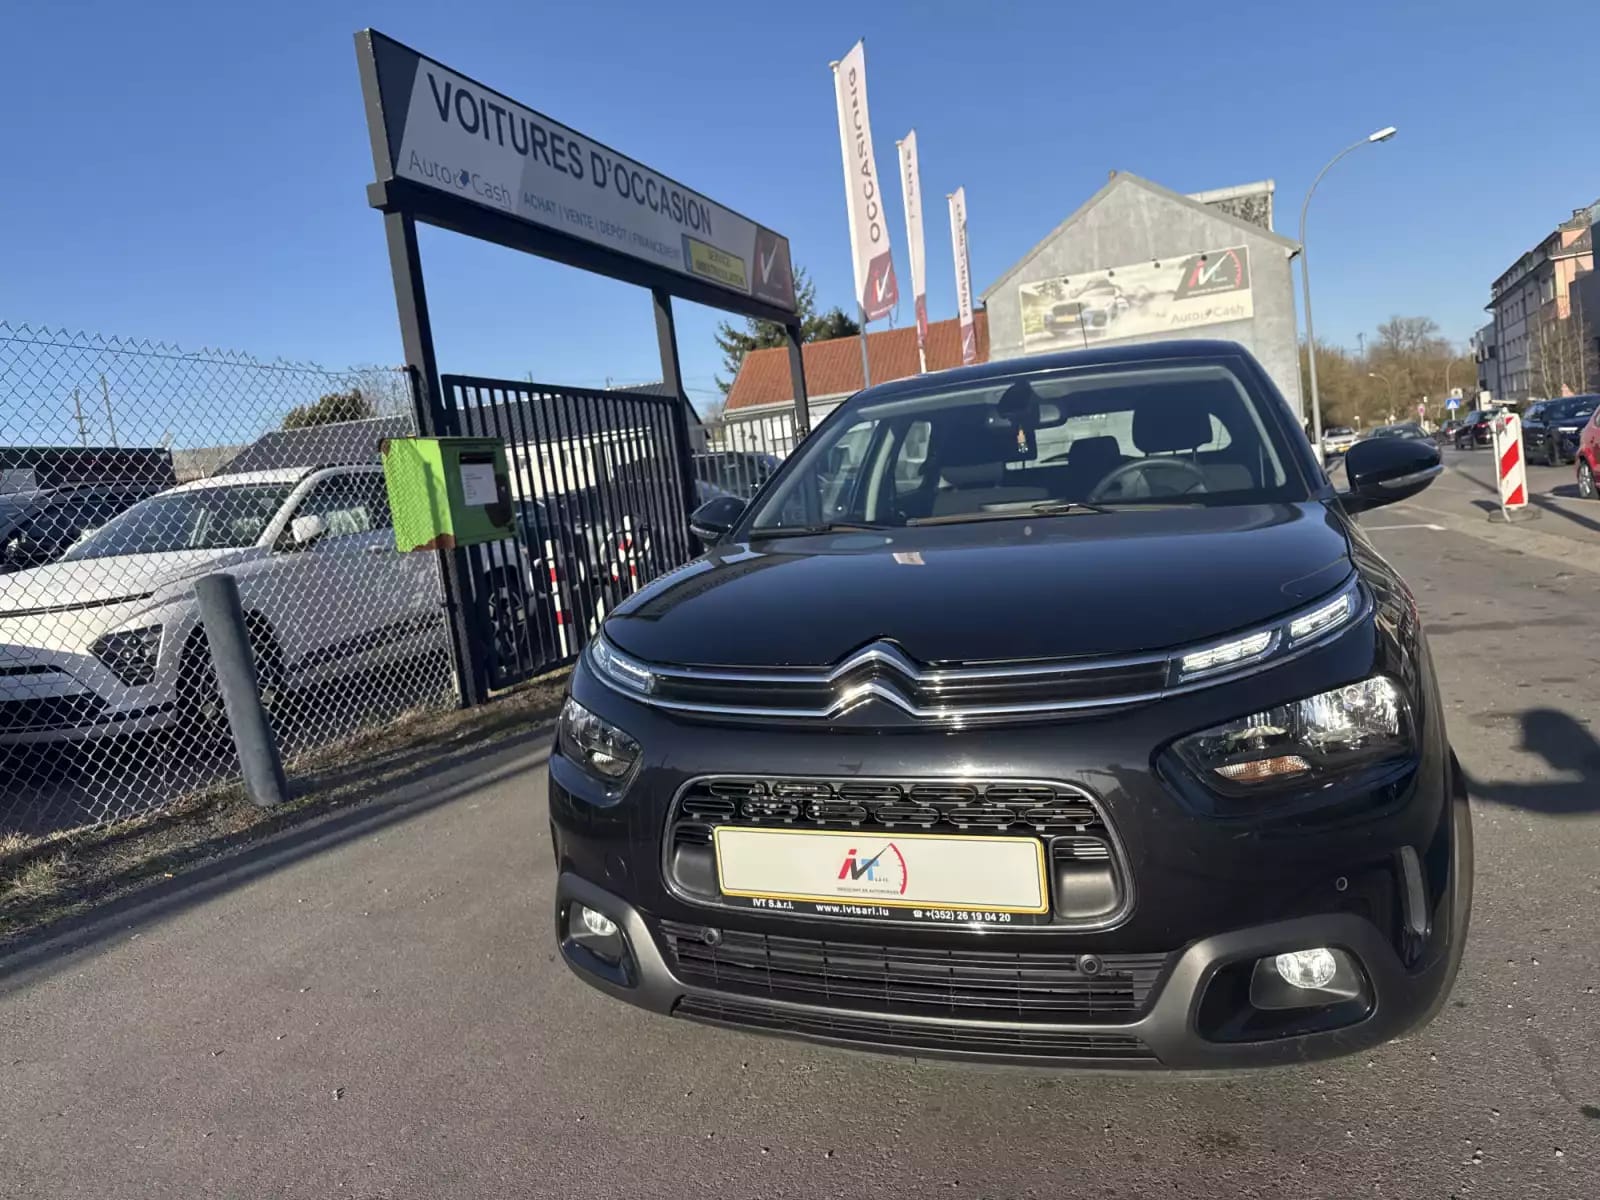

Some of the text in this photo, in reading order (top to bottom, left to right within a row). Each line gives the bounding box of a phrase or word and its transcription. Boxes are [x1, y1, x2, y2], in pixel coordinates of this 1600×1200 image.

[427, 72, 713, 236] VOITURES D'OCCASION
[523, 192, 556, 215] ACHAT
[565, 208, 594, 231] VENTE
[753, 898, 767, 908] IVT
[815, 904, 889, 916] www.ivtsarl.lu
[925, 909, 1011, 922] +(352) 26 19 04 20
